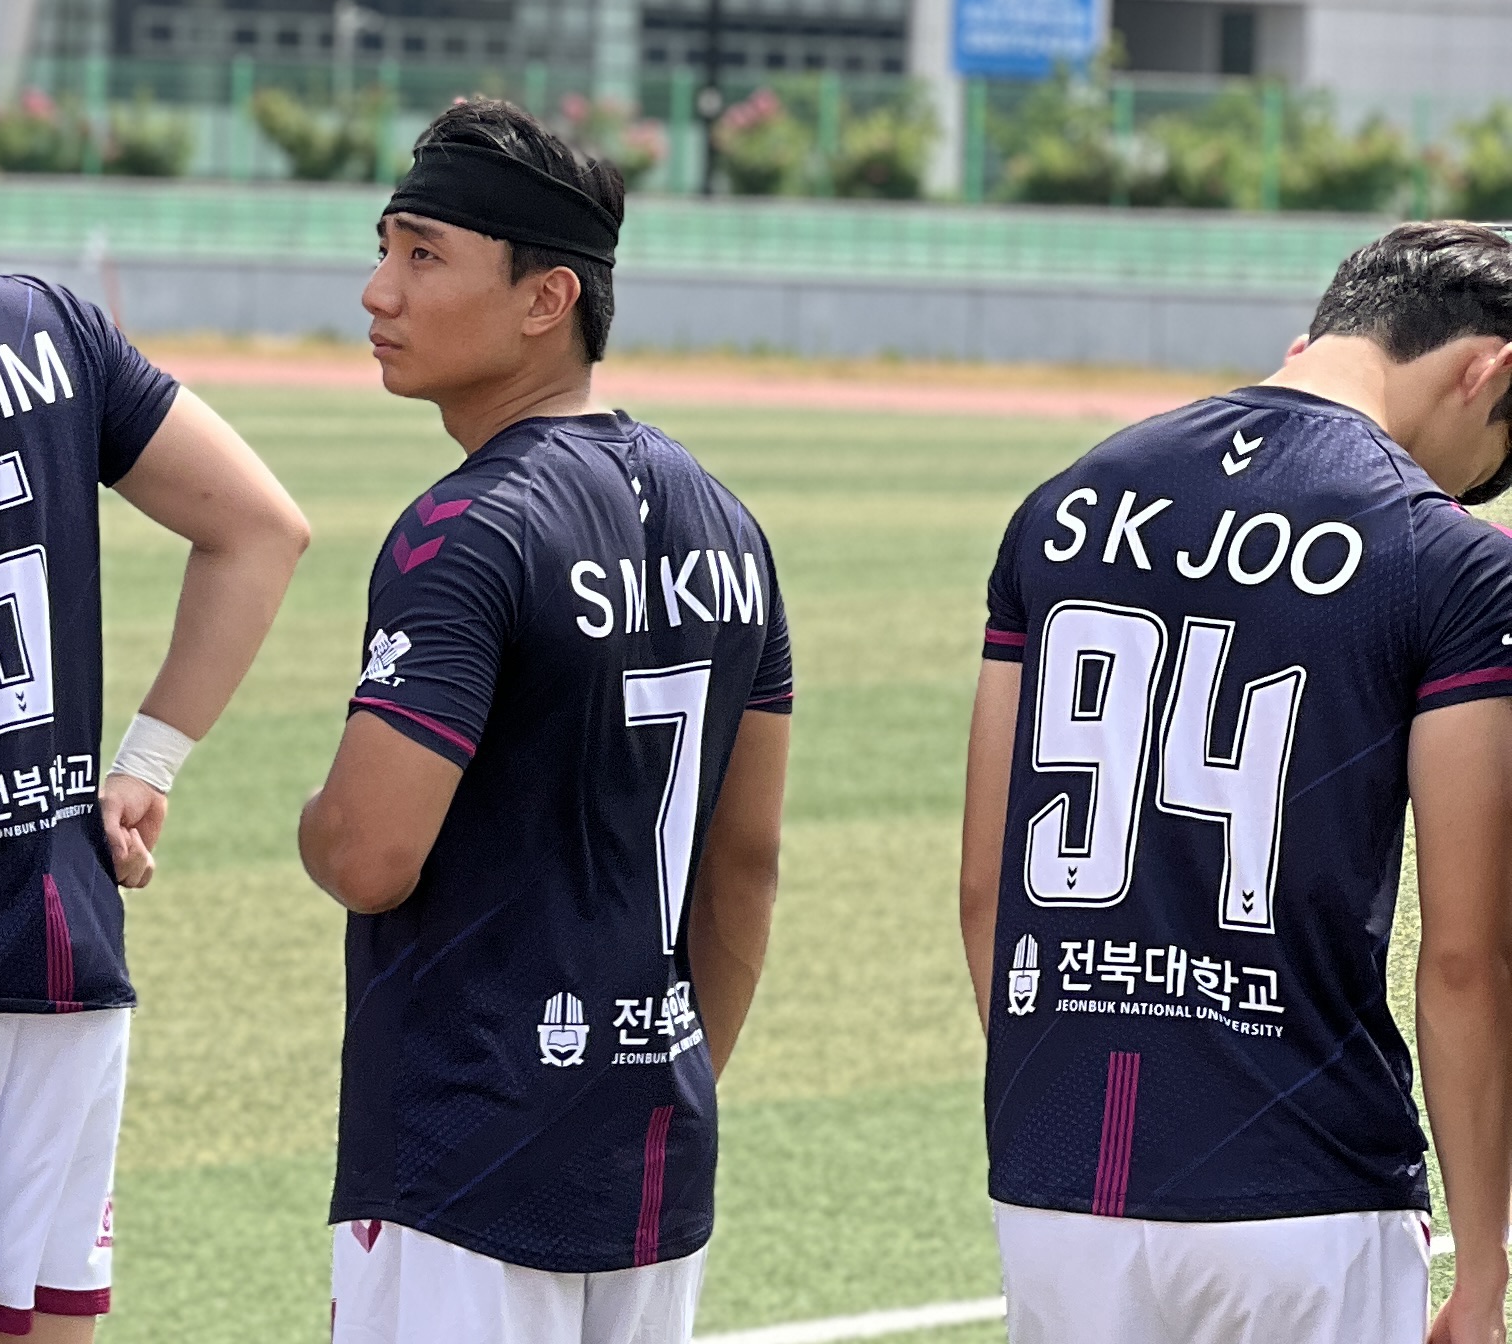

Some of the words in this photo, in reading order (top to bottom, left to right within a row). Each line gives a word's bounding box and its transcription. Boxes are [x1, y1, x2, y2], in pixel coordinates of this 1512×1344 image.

[660, 549, 765, 628] KIM
[1176, 509, 1364, 596] JOO
[1024, 599, 1307, 934] 94
[622, 659, 713, 956] 7
[1057, 939, 1286, 1015] 전북대학교
[1055, 998, 1117, 1014] JEONBUK
[1119, 1001, 1193, 1019] NATIONAL
[1195, 1006, 1286, 1038] UNIVERSITY
[611, 1052, 669, 1065] JEONBUK
